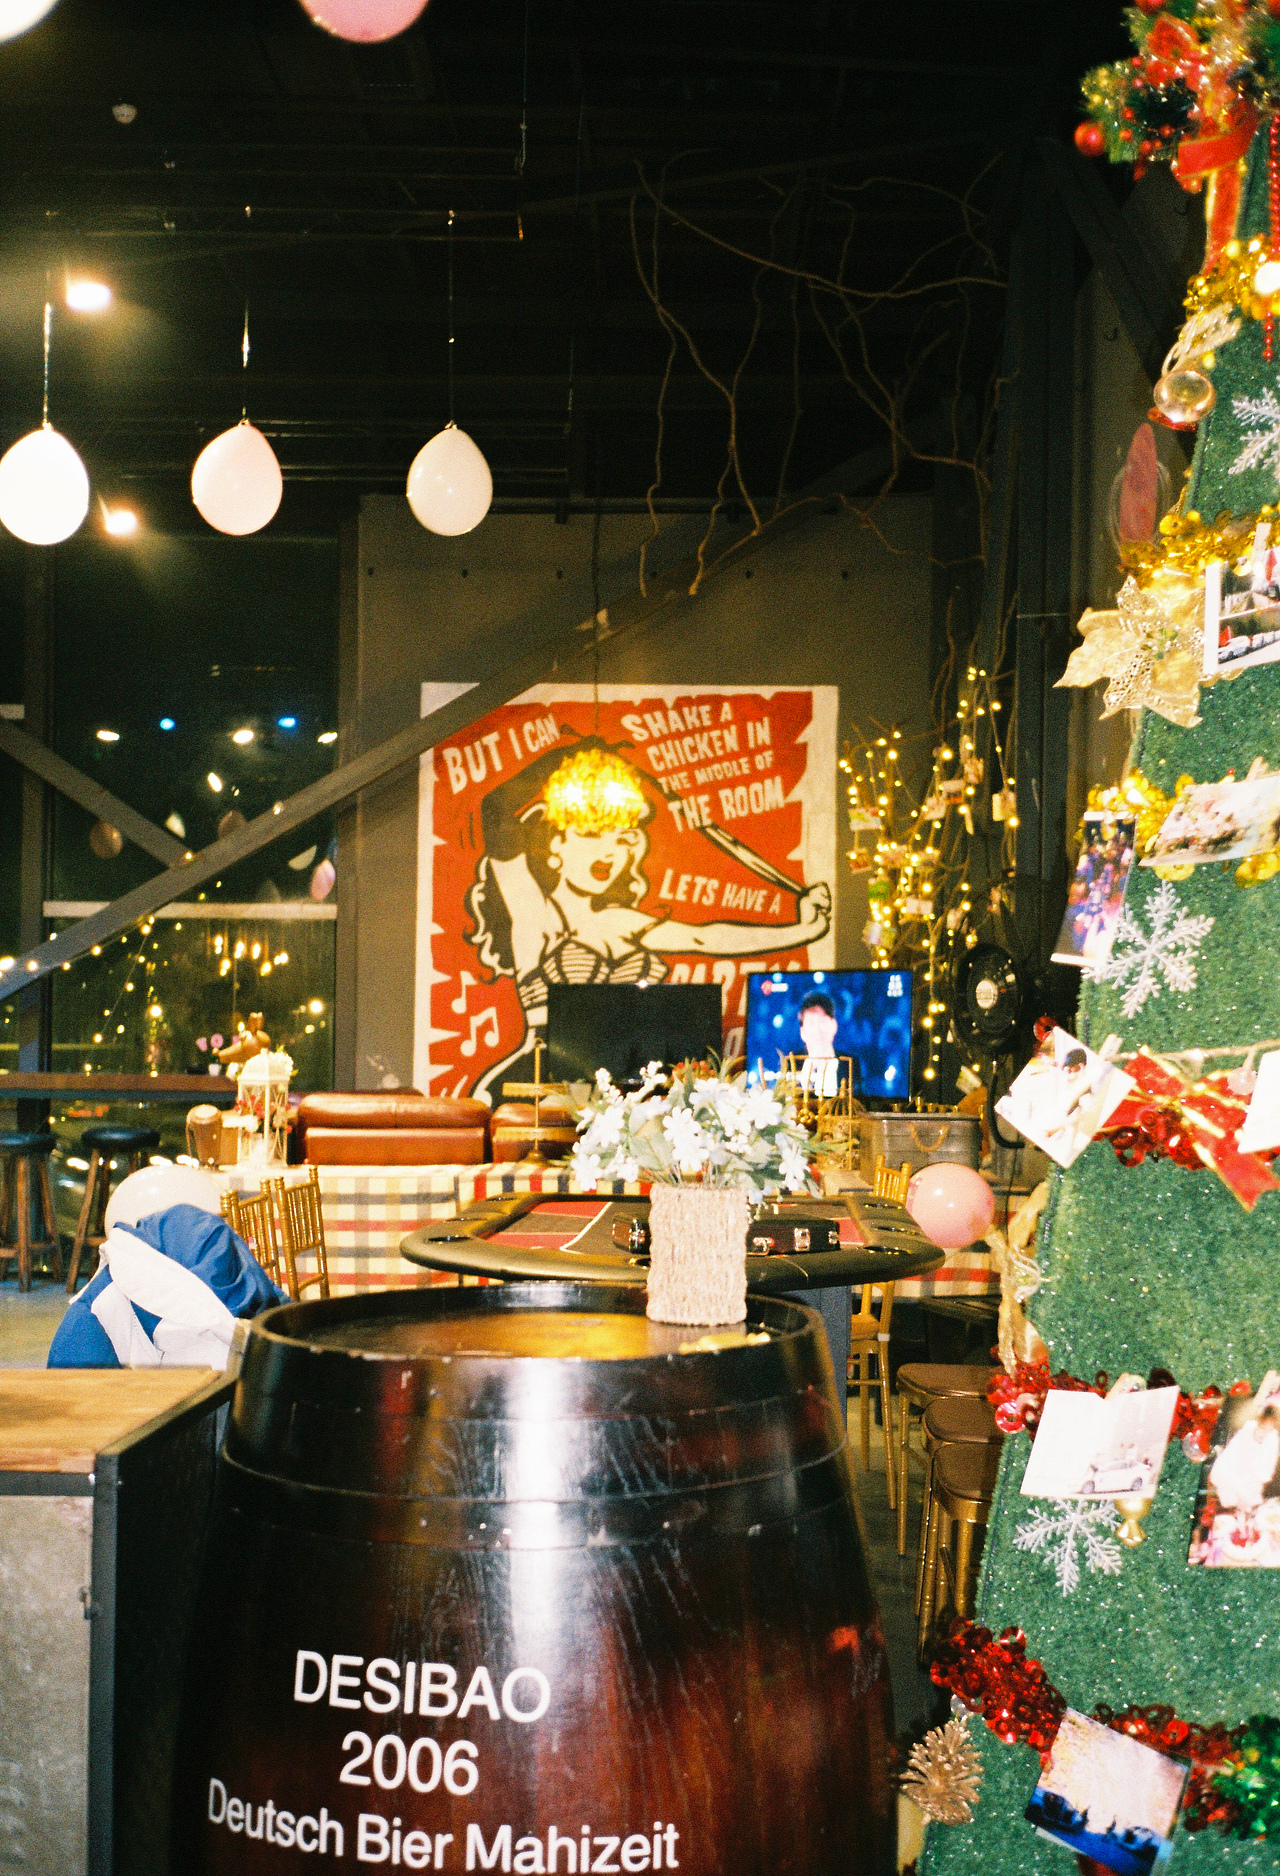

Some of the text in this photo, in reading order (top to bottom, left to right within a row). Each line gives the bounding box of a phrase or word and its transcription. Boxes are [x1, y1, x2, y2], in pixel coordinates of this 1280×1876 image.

[621, 702, 733, 742] SHAKE A
[647, 716, 771, 772] CHICKEN IN
[442, 713, 560, 795] BUT I CAN
[658, 750, 773, 794] THE MIDDLE OF
[668, 776, 785, 832] THE ROOM
[658, 868, 781, 915] LETS HAVE A
[294, 1650, 551, 1723] DESIBAO
[339, 1731, 479, 1796] 2006
[208, 1778, 680, 1875] Deutsch Bier Mahizeit
